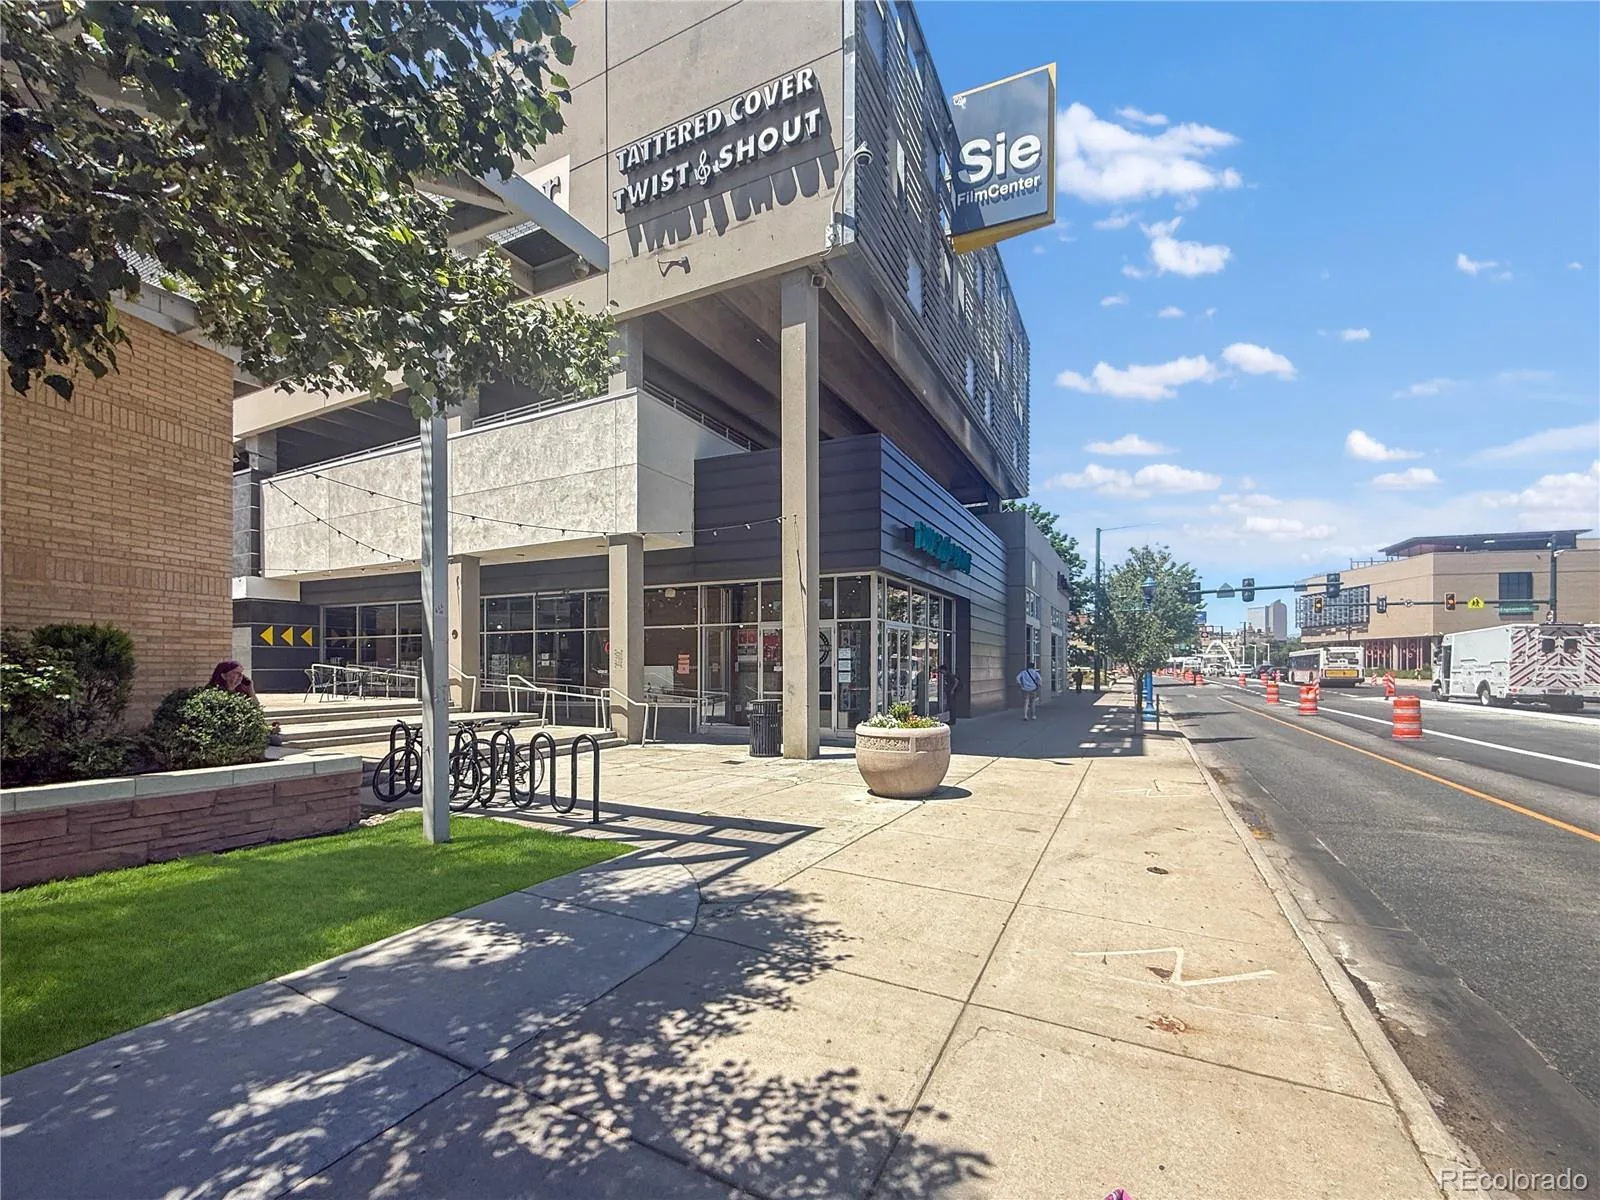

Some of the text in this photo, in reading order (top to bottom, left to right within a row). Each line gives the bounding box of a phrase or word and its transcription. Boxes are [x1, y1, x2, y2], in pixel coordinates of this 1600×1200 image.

[613, 161, 691, 211] TWIST
[719, 107, 821, 169] SHOUT
[616, 68, 814, 173] TATTERED COVER
[958, 132, 1041, 184] Sie
[957, 175, 1041, 206] FilmCenter
